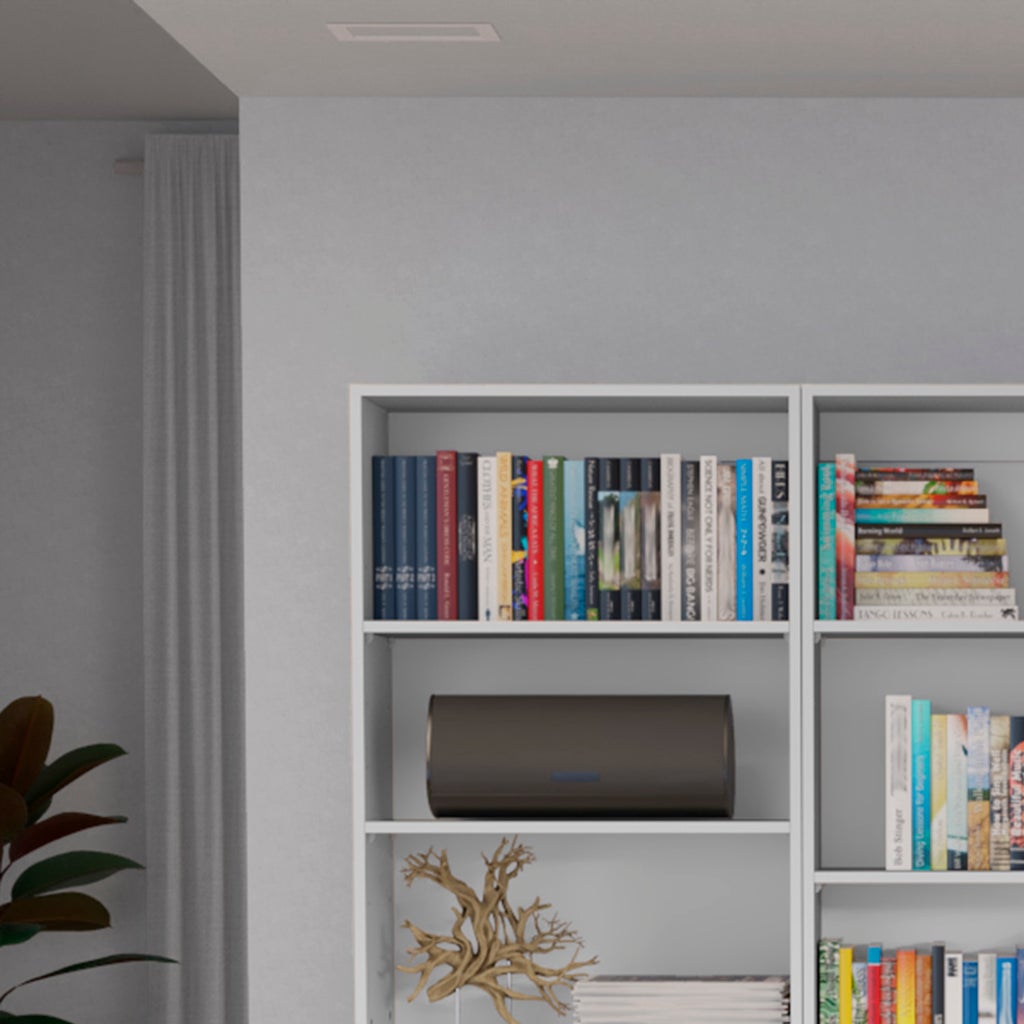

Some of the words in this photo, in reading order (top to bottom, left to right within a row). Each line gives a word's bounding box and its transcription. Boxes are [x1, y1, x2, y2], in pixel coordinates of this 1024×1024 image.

[482, 459, 494, 511] CLOTHES
[704, 459, 714, 494] SCIENCE
[704, 495, 714, 514] NOT
[704, 516, 714, 543] ONLY
[757, 496, 768, 563] GUNPOWDER
[884, 527, 903, 535] World
[704, 545, 714, 563] FOR
[685, 568, 697, 585] BIG
[915, 806, 925, 839] Lessons
[1010, 784, 1022, 837] Beautiful
